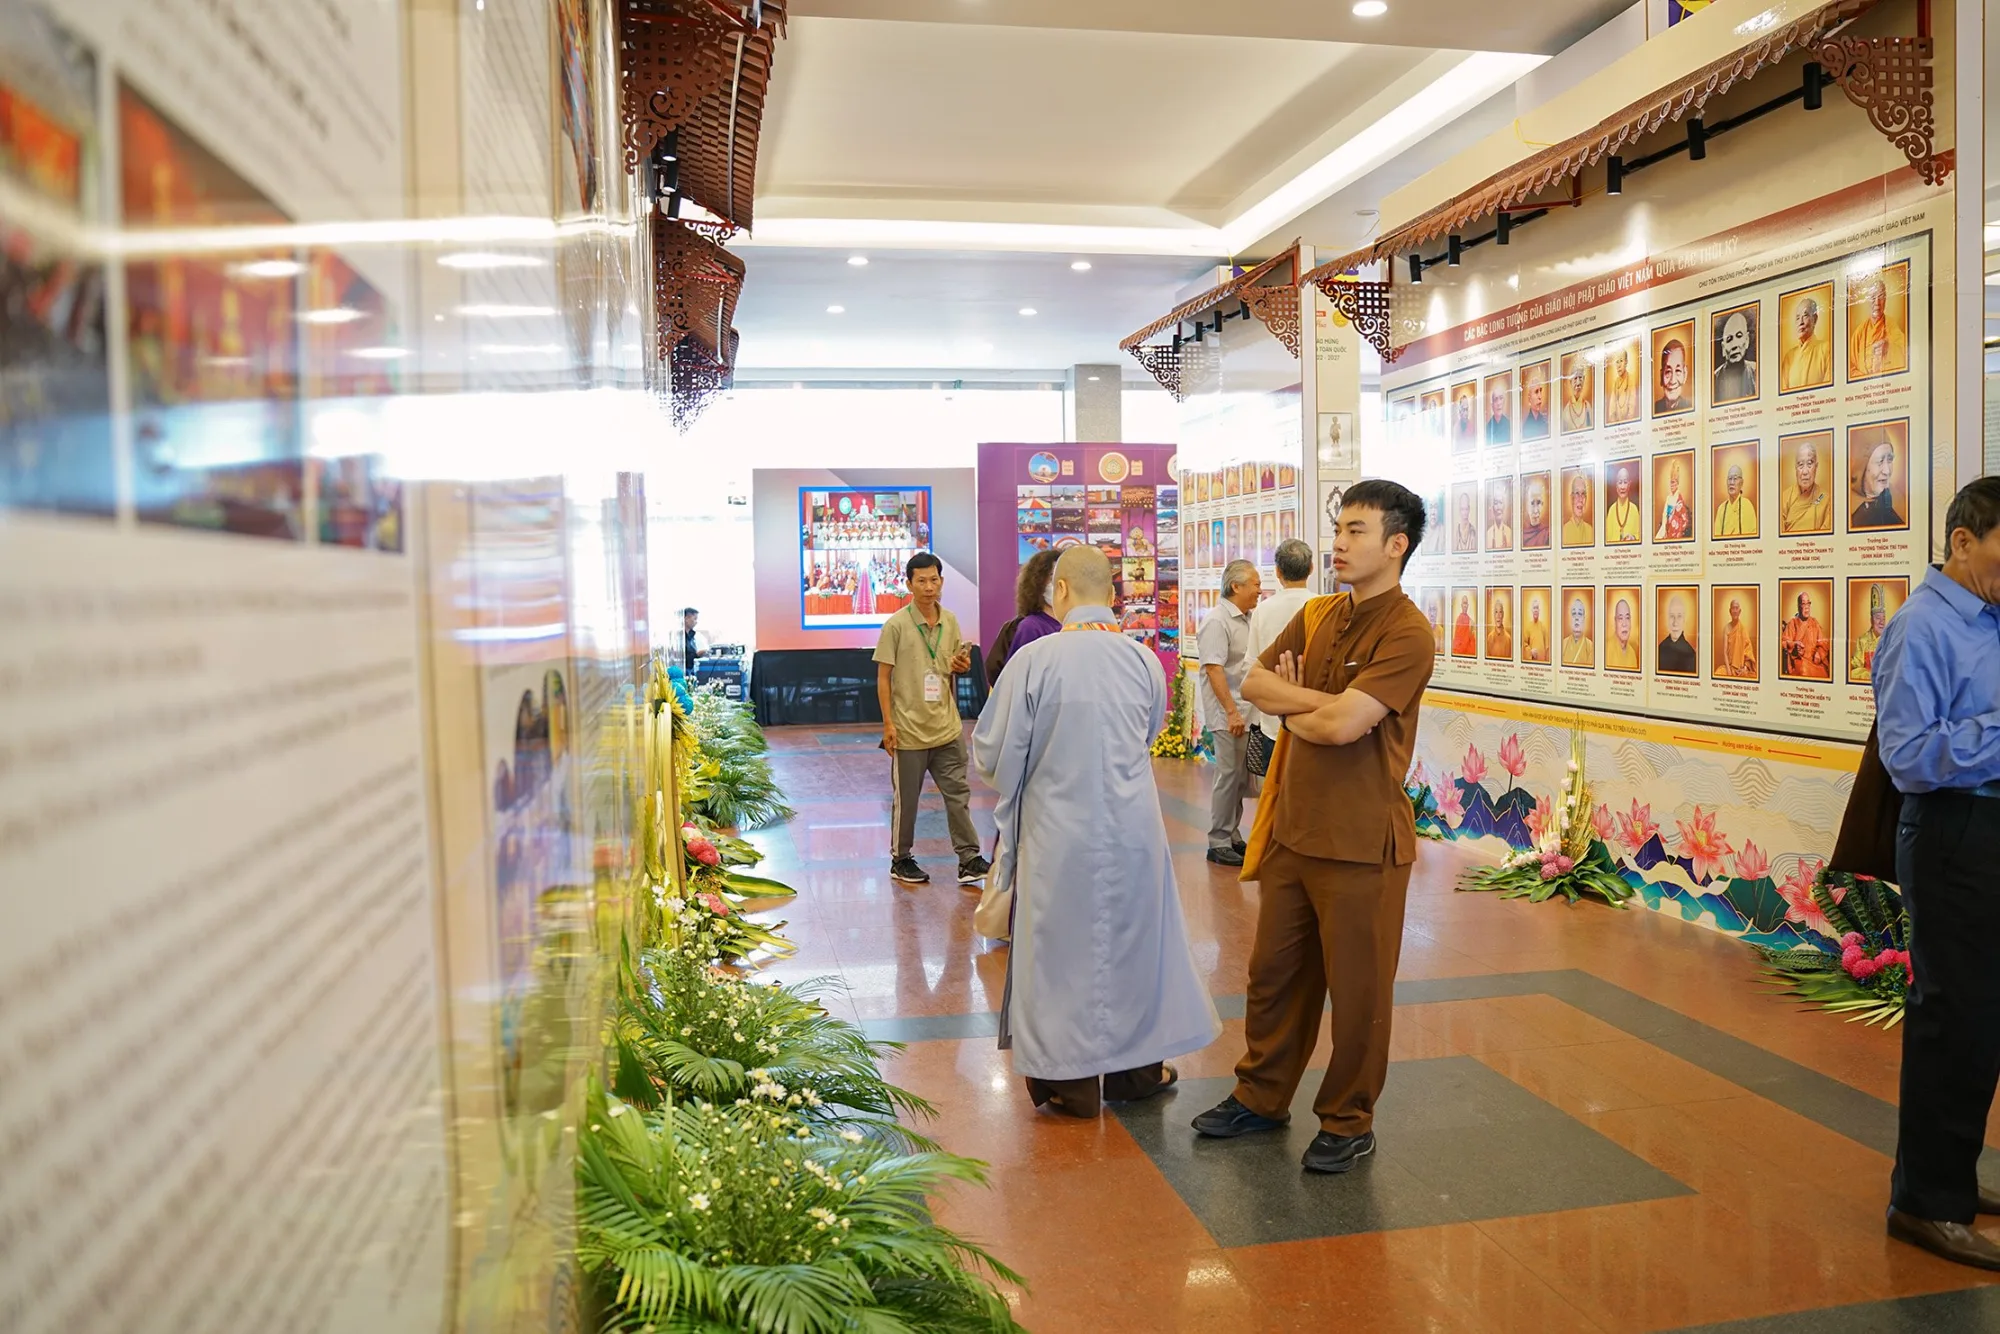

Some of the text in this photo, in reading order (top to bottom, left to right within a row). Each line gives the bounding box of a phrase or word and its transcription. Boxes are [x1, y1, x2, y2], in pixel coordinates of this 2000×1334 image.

[1912, 212, 1925, 222] NAM
[1489, 318, 1504, 333] LONG
[1529, 303, 1544, 320] CỦA
[1544, 298, 1561, 315] GIÁO
[1578, 286, 1596, 304] PHẬT
[1618, 272, 1634, 290] VIỆT
